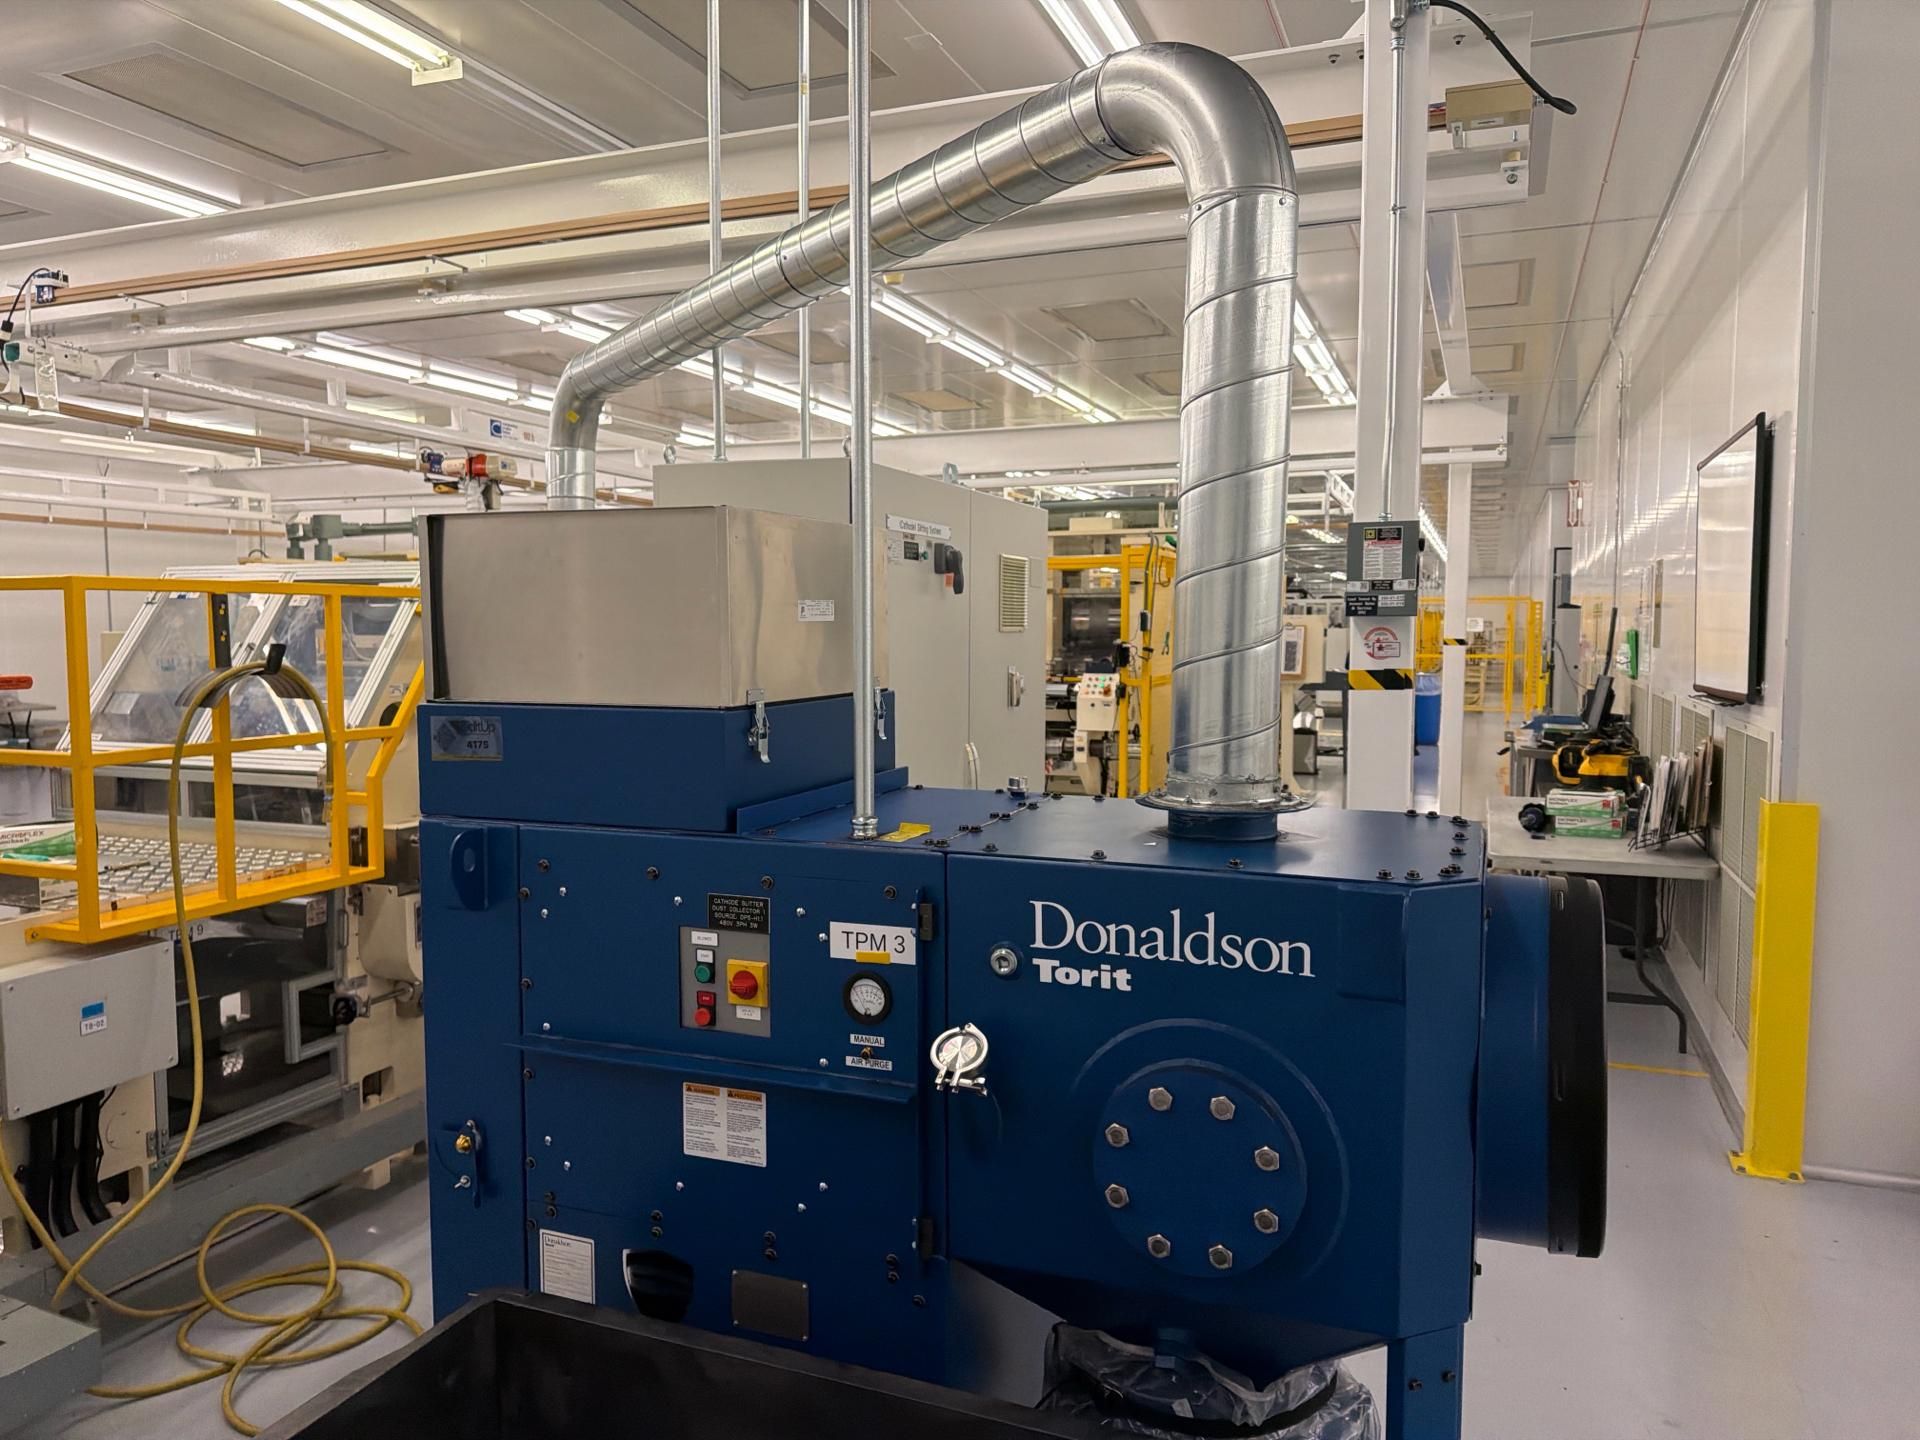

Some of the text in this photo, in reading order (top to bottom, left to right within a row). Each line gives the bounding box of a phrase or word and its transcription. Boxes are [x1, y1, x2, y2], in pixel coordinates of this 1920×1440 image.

[713, 898, 739, 906] CATHODE
[711, 905, 727, 913] DUST
[729, 906, 760, 914] COLLECTOR
[197, 924, 204, 936] 9
[841, 930, 906, 954] TPM 3
[1029, 900, 1316, 978] Donaldson
[1032, 958, 1133, 992] Torit
[853, 1035, 884, 1046] MANUAL
[850, 1057, 890, 1070] AIR PURGE
